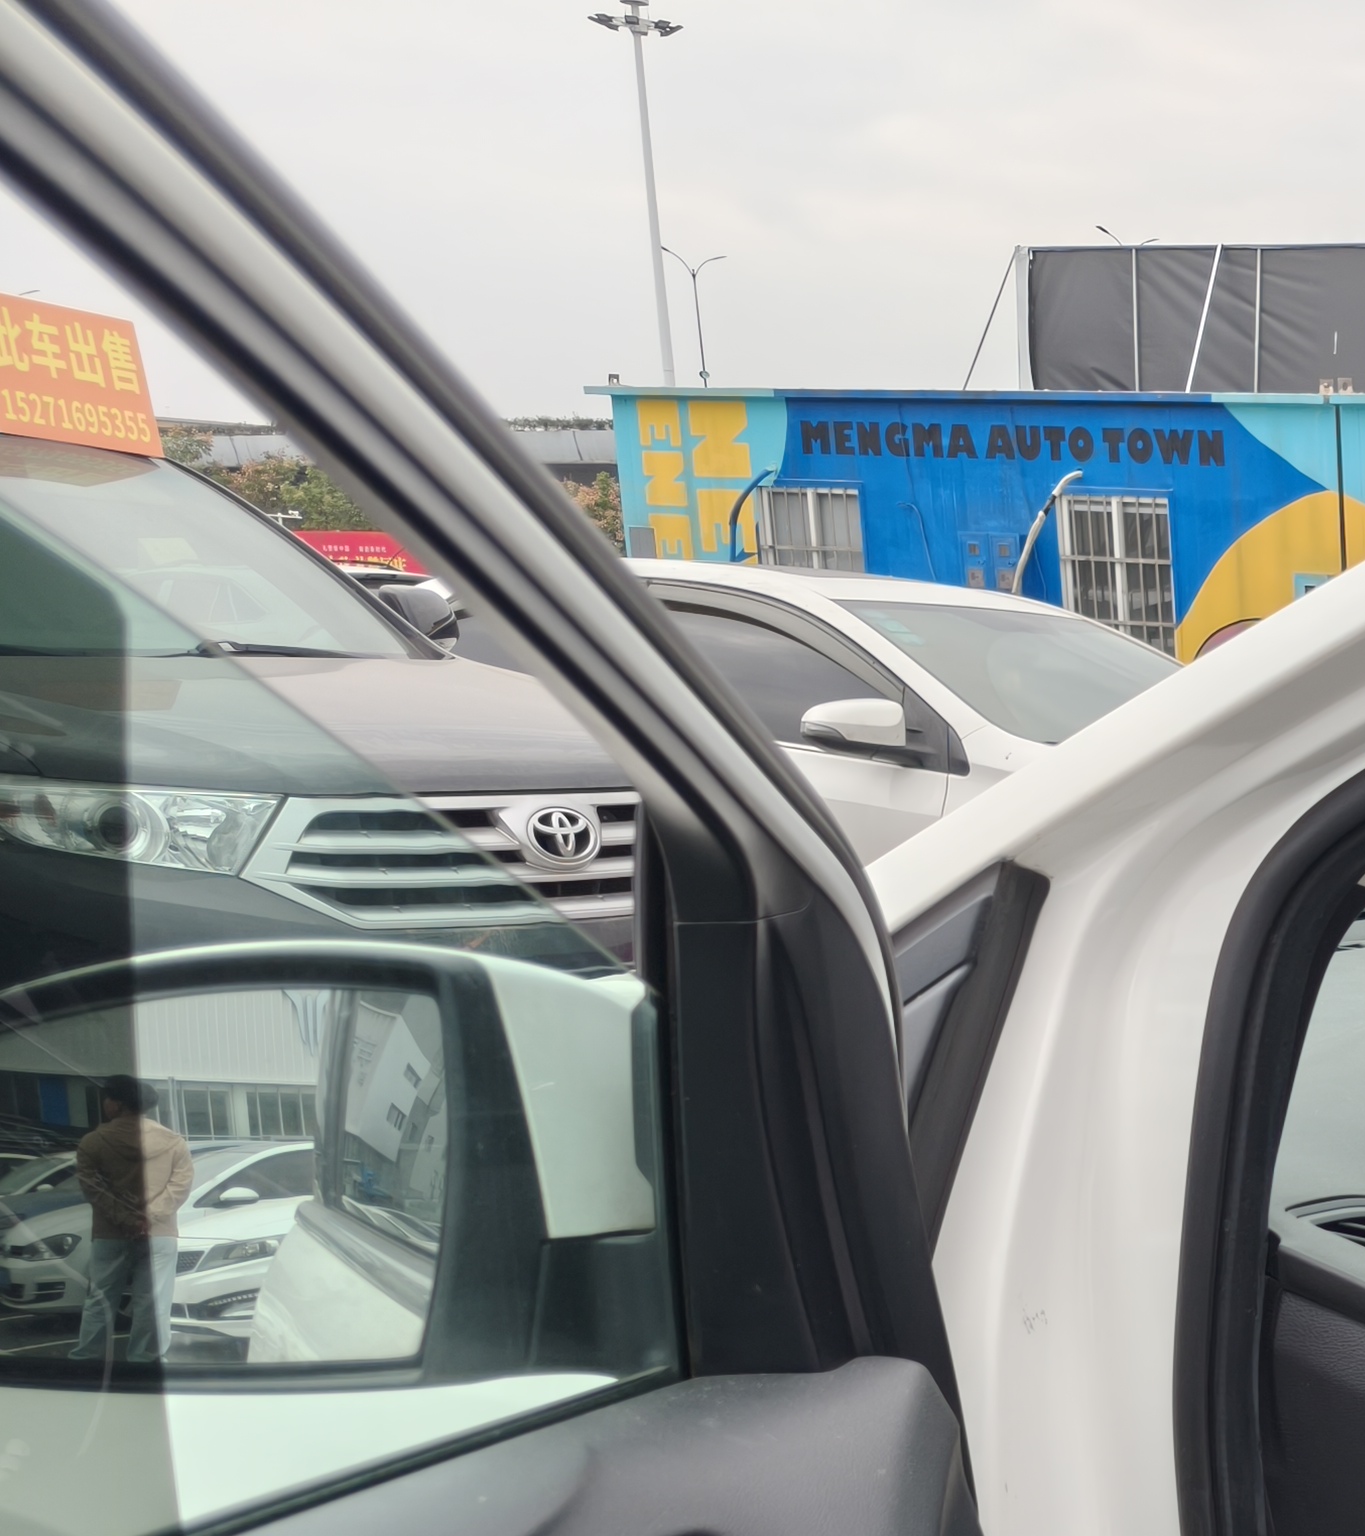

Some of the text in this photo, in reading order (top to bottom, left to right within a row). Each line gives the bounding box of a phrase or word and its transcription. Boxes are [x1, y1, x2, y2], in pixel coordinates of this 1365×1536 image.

[0, 306, 141, 395] 此车出售
[1, 388, 152, 443] 15271695355
[800, 420, 1226, 467] MENGMA AUTO TOWN
[687, 401, 758, 564] NE
